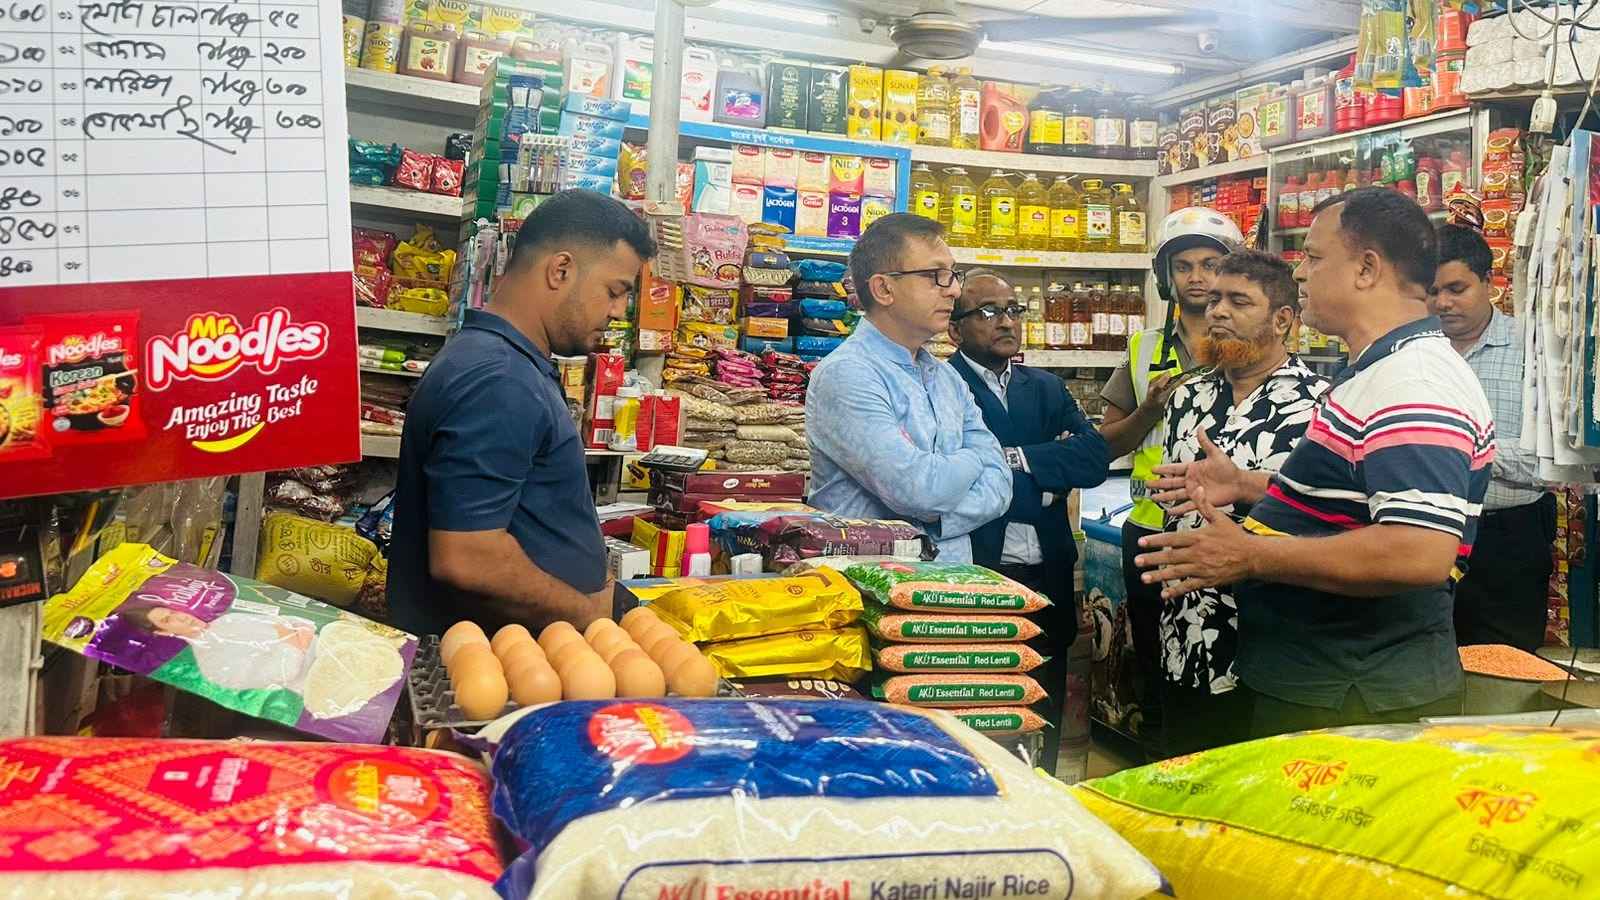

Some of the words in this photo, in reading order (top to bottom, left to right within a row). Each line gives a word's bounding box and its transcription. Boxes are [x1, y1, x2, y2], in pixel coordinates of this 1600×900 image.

[263, 42, 306, 65] ২০০
[841, 216, 848, 226] 3
[190, 315, 237, 340] Mr.
[49, 333, 120, 366] Noodles
[152, 310, 323, 383] Noodles
[51, 367, 103, 388] Korean
[163, 392, 262, 431] Amazing
[266, 374, 319, 404] Taste
[186, 419, 229, 440] Enjoy
[230, 412, 261, 430] The
[267, 399, 303, 424] Best
[981, 596, 995, 605] Red
[996, 597, 1015, 606] Lentil
[929, 625, 967, 635] Essential
[972, 626, 987, 635] Red
[988, 626, 1008, 635] Lentil
[931, 655, 969, 665] Essential
[974, 656, 988, 665] Red
[990, 656, 1010, 665] Lentil
[936, 687, 974, 697] Essential
[979, 688, 993, 697] Red
[995, 688, 1015, 697] Lentil
[975, 718, 990, 728] Red
[991, 718, 1012, 728] Lentil
[715, 879, 851, 900] Essential
[870, 877, 937, 900] Katari
[944, 875, 996, 900] Najir
[1003, 873, 1051, 897] Rice
